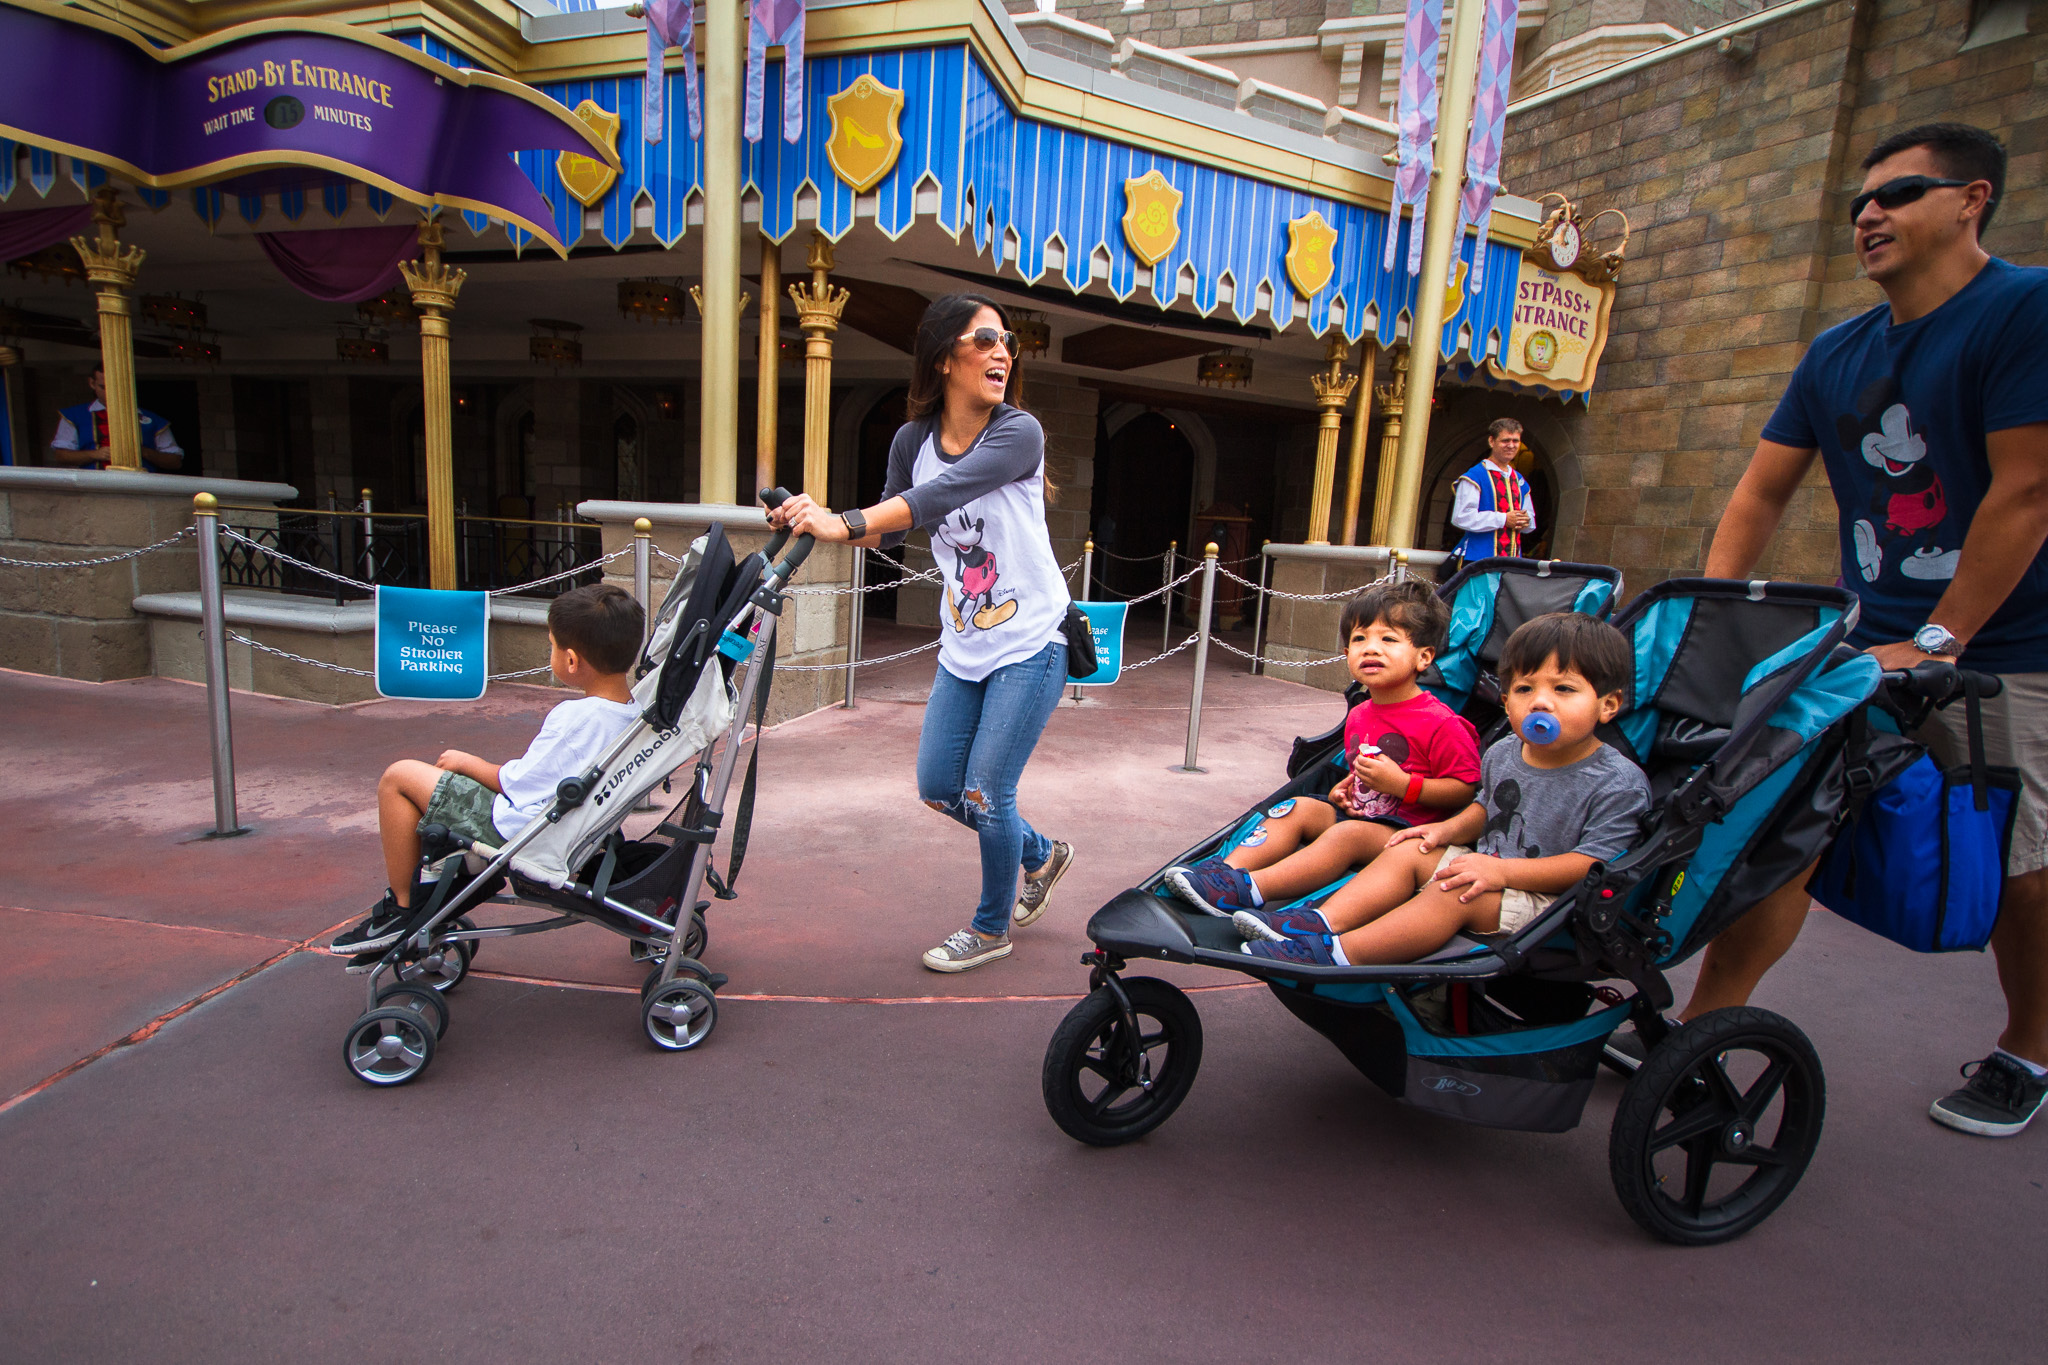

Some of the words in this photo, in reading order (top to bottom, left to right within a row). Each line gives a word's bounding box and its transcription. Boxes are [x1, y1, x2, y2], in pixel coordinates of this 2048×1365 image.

[207, 60, 286, 103] STAND-BY
[291, 59, 394, 109] ENTRANCE
[203, 114, 229, 136] WAIT
[230, 106, 256, 126] TIME
[313, 104, 373, 132] MINUTES
[1519, 281, 1591, 313] STPASS+
[1514, 304, 1589, 340] NTRANCE
[997, 587, 1016, 597] Disney
[408, 621, 458, 635] Please
[1091, 627, 1109, 635] ease
[421, 635, 445, 647] No
